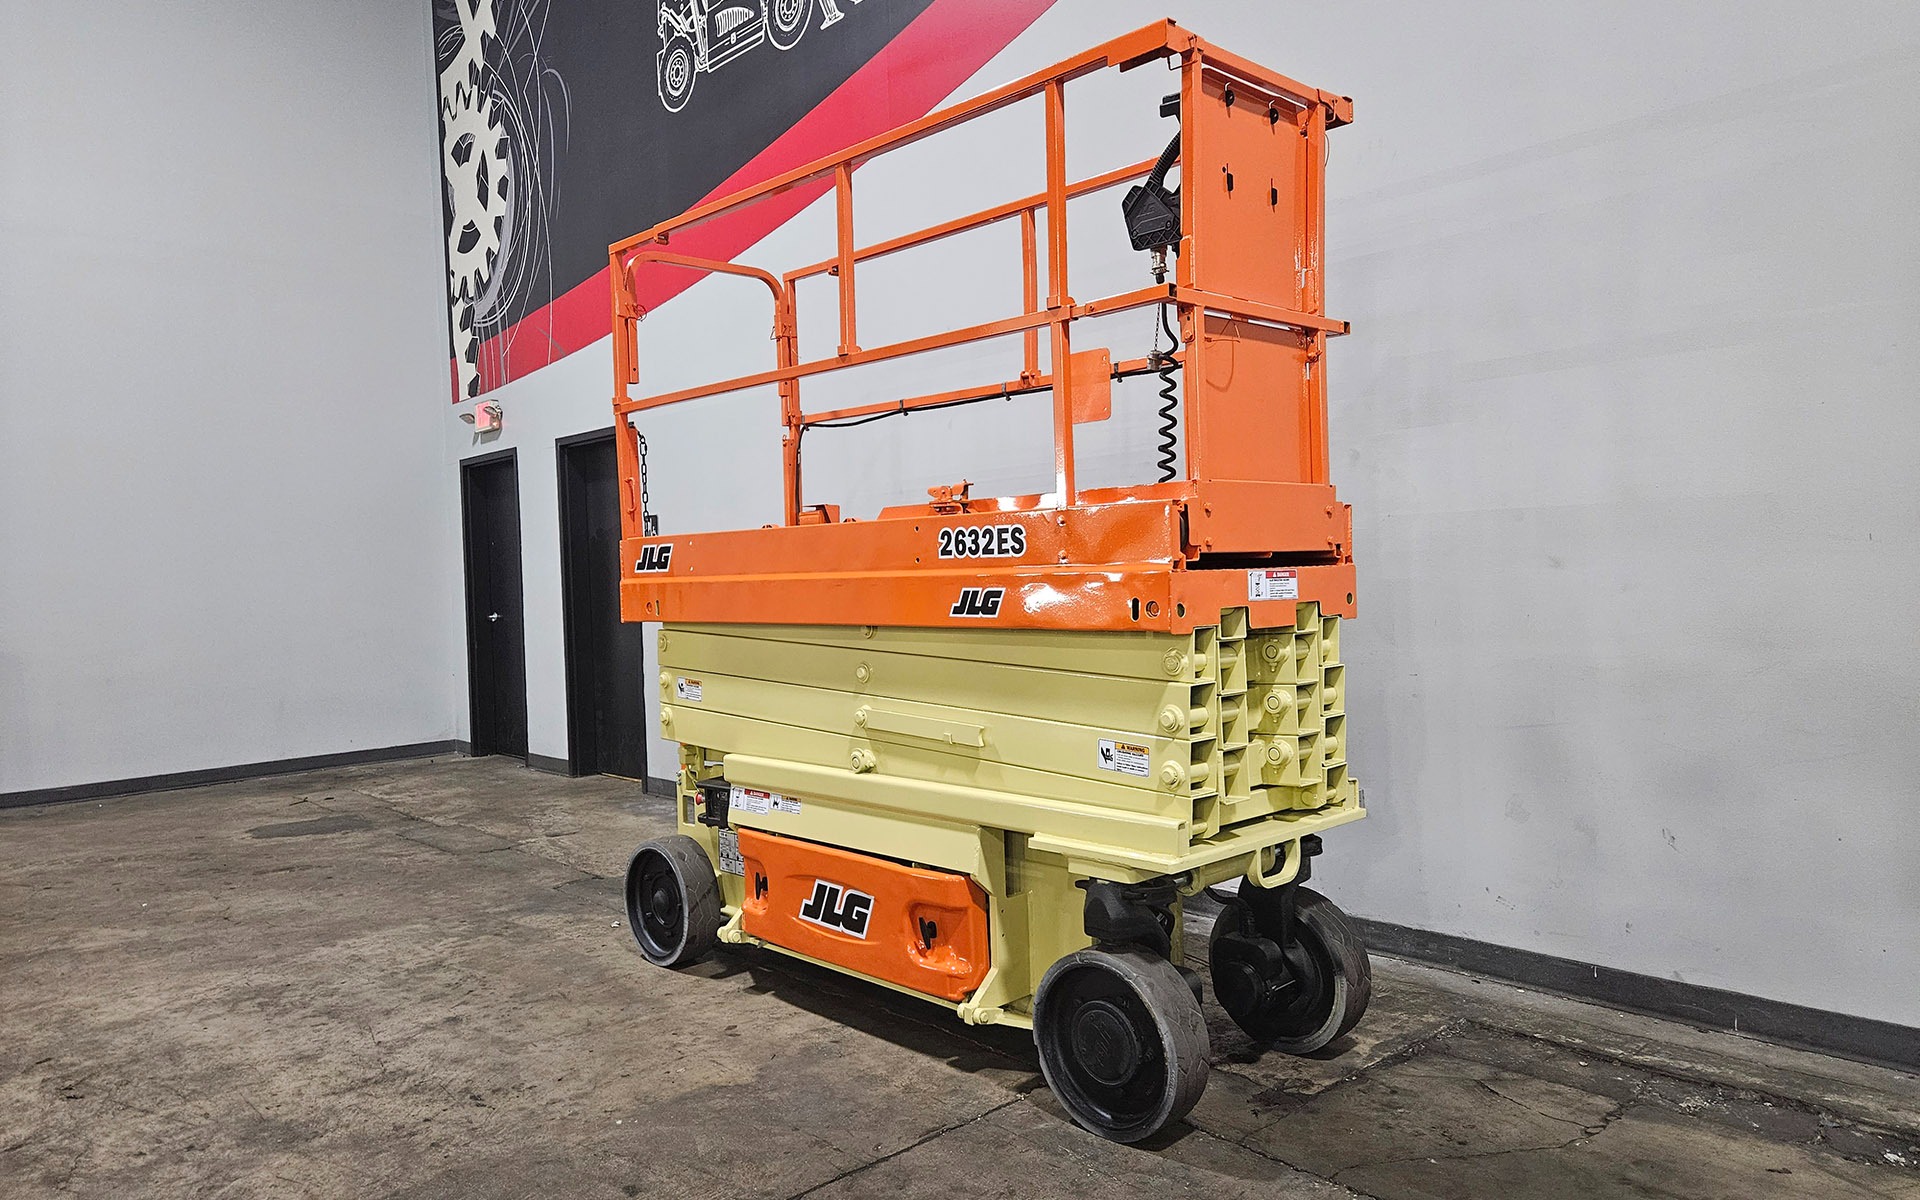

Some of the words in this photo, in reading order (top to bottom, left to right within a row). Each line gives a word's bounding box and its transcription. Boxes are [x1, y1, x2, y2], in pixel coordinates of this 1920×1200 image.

[939, 526, 1025, 557] 2632ES
[636, 545, 672, 571] JLG
[951, 589, 1004, 616] JLG
[801, 881, 873, 936] JLG
